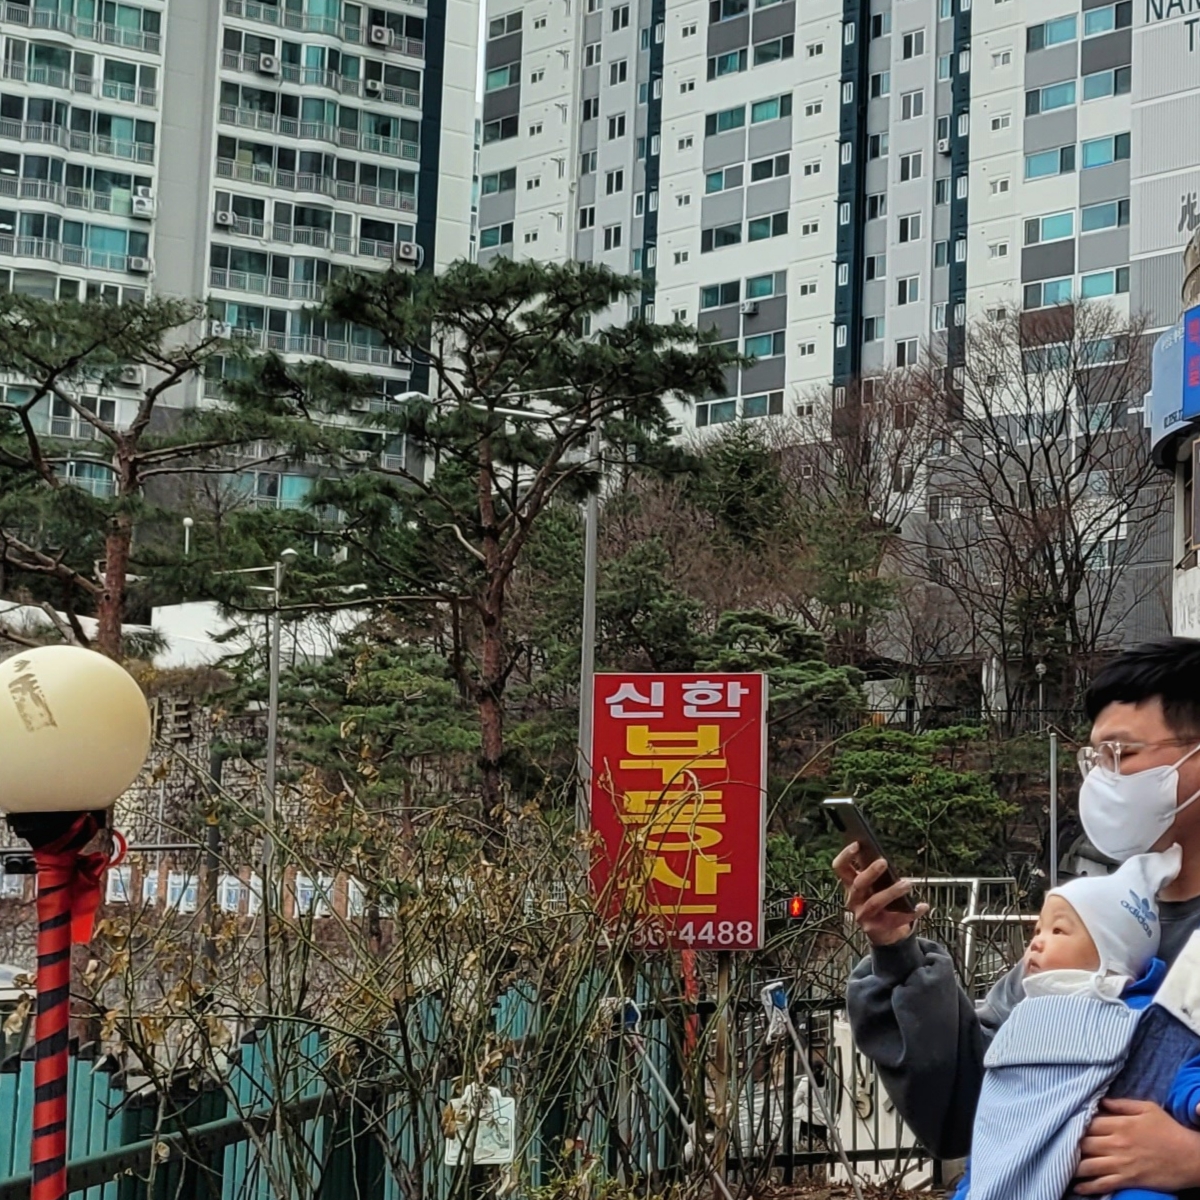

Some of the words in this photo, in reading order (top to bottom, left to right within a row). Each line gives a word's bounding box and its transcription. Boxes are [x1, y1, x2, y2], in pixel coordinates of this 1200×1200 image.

[605, 680, 750, 719] 신한
[617, 724, 731, 915] 부동산
[1120, 900, 1152, 939] adidas
